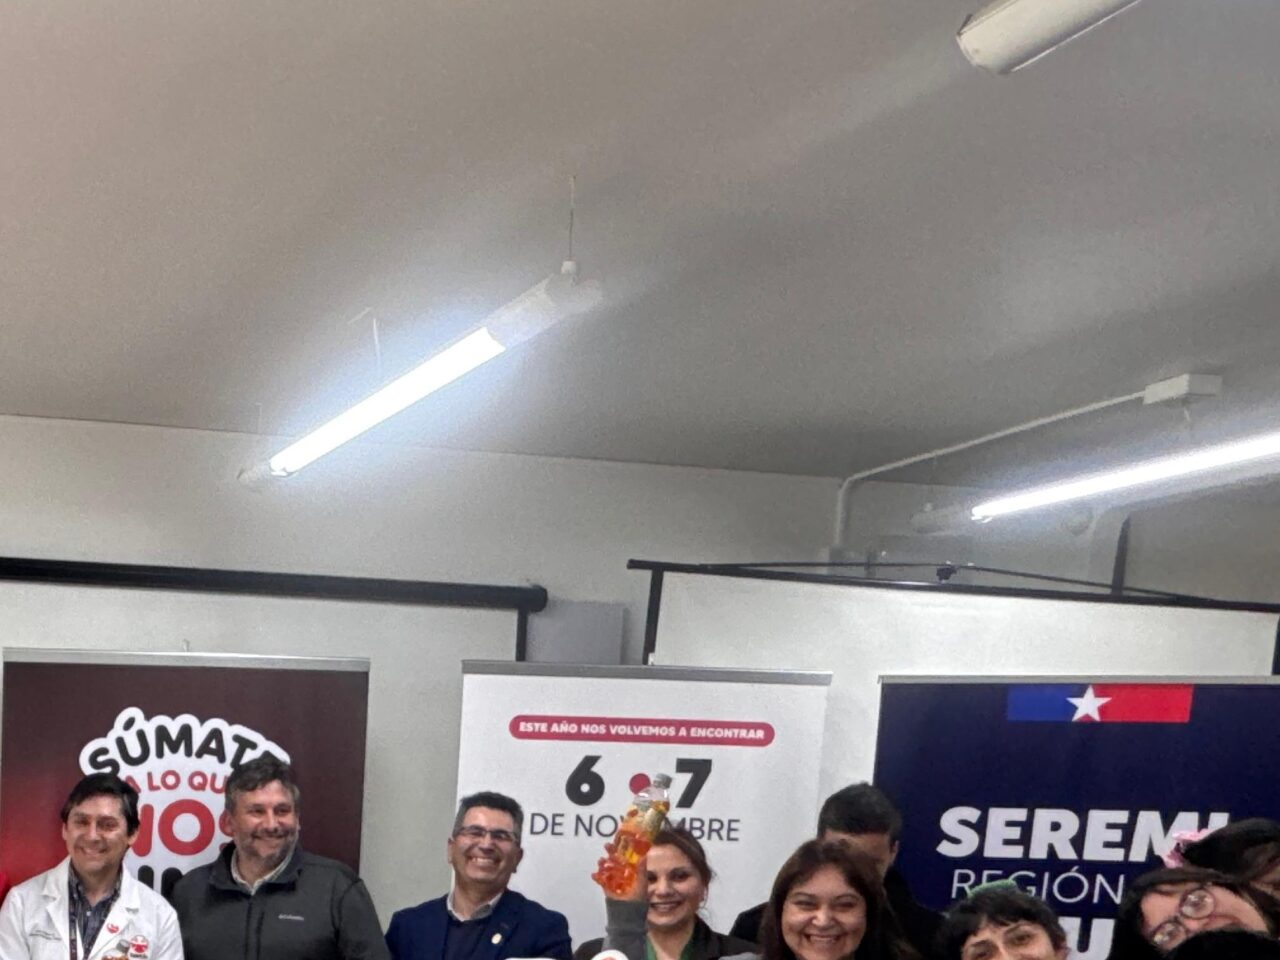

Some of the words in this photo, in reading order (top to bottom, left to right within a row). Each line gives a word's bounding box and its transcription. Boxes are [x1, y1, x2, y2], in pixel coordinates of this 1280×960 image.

[519, 721, 548, 732] ESTE
[550, 720, 578, 733] AÑO
[580, 723, 607, 734] NOS
[609, 724, 676, 736] VOLVEMOS
[678, 726, 687, 737] A
[690, 727, 765, 739] ENCONTRAR
[88, 716, 276, 776] SÚMAT
[147, 769, 181, 792] LO
[188, 770, 227, 794] QU
[565, 755, 605, 806] 6
[675, 758, 712, 808] 7
[529, 813, 565, 836] DE
[574, 815, 740, 842] NOBRE
